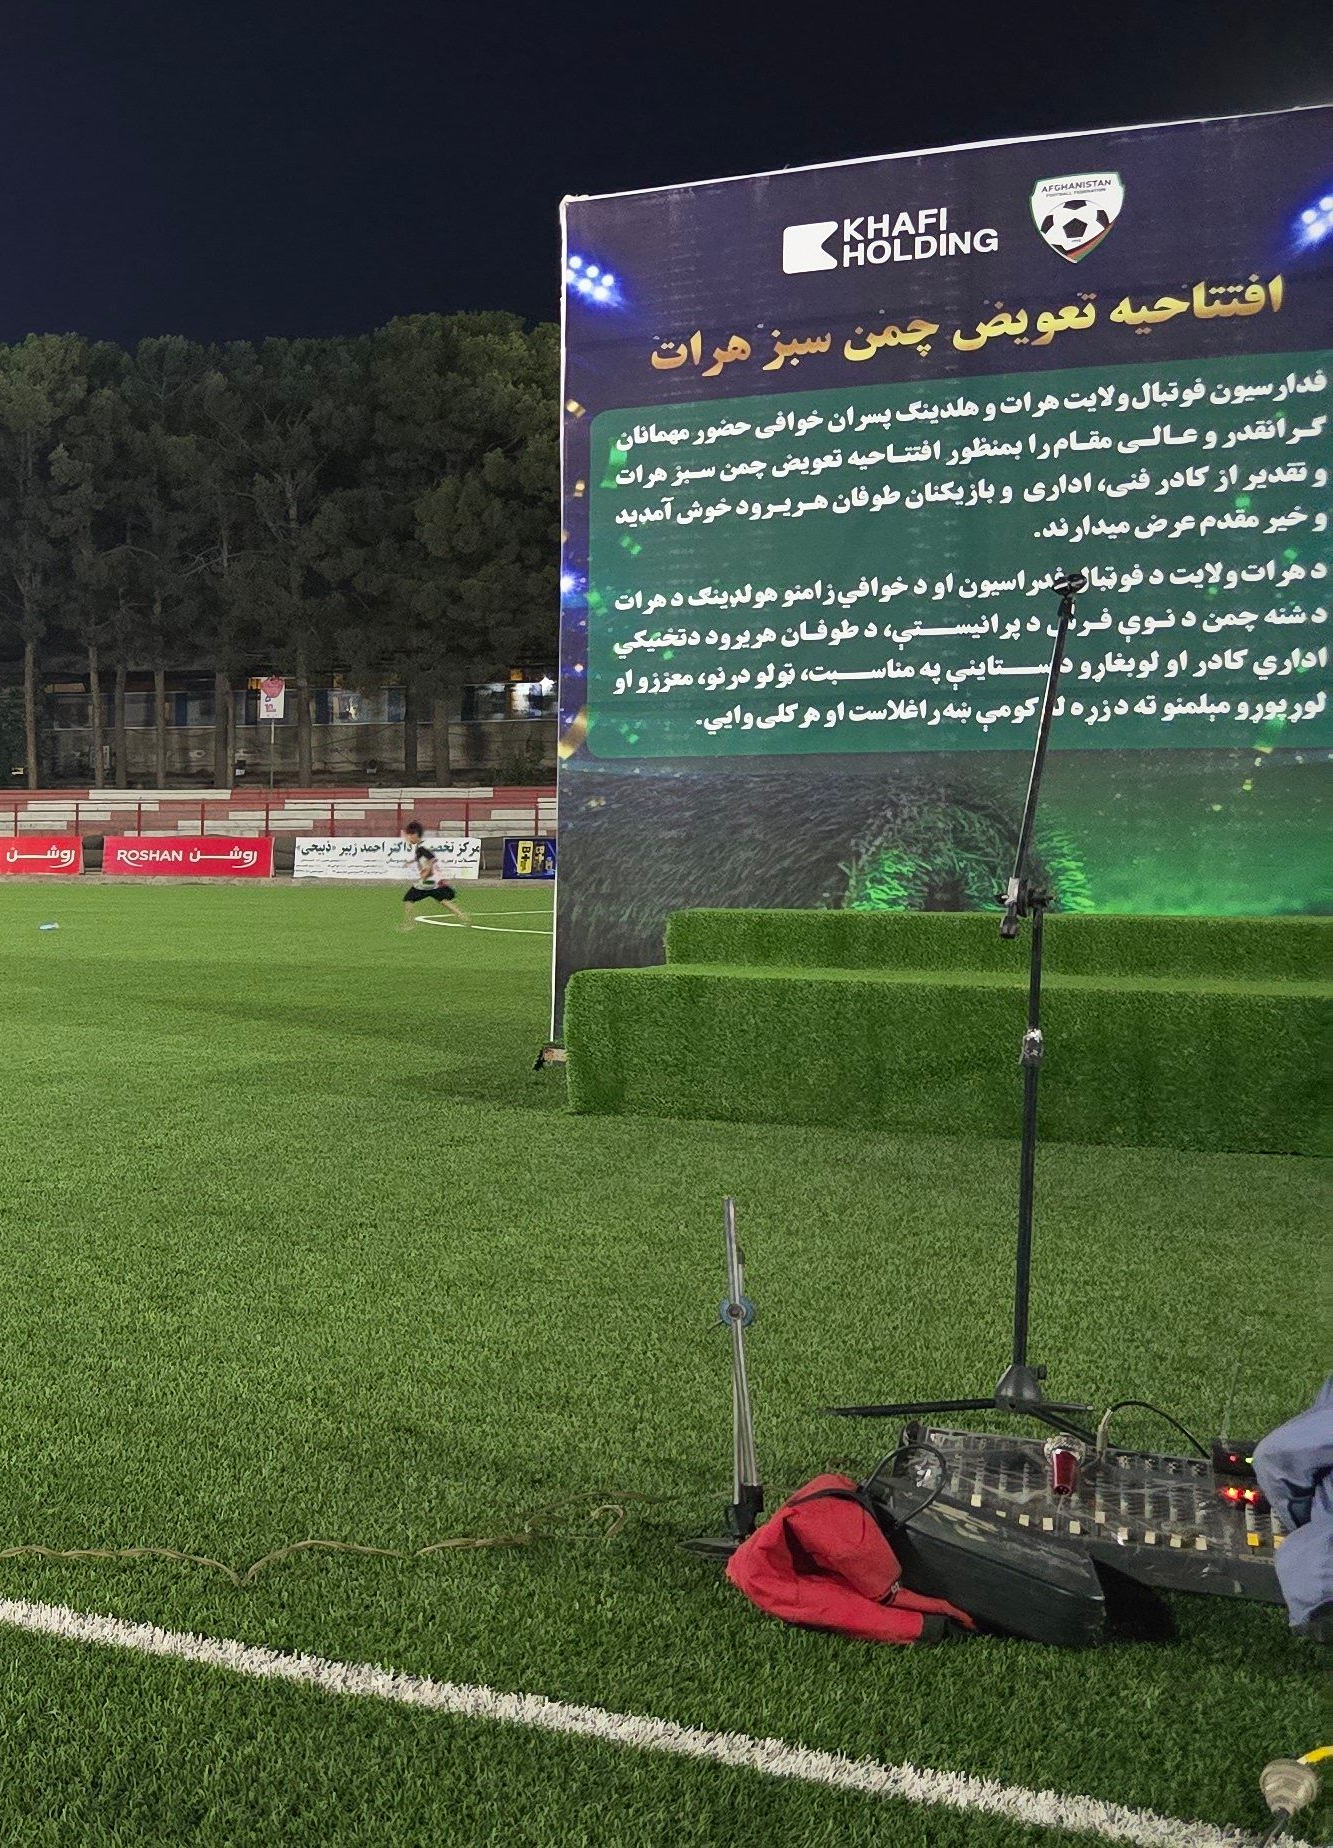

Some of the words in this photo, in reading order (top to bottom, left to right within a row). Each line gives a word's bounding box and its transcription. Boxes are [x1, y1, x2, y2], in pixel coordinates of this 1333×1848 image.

[1041, 180, 1112, 193] AFGHANISTAN
[844, 208, 947, 247] KHAFI
[843, 223, 998, 267] HOLDING
[1110, 274, 1283, 334] افتتاحیه
[952, 294, 1097, 352] تعویض
[758, 324, 830, 370] سبز
[844, 320, 939, 361] چمن
[651, 331, 750, 377] هرات
[1064, 385, 1129, 412] ولایت
[1132, 378, 1205, 409] فوتبال
[1210, 370, 1327, 404] فدارسیون
[983, 403, 996, 421] و
[1000, 392, 1059, 417] هرات
[755, 410, 823, 439] خوافی
[828, 406, 891, 432] پسران
[616, 424, 689, 451] مهمانان
[692, 419, 751, 445] حضور
[1054, 431, 1112, 458] مقام
[1203, 431, 1217, 449] و
[848, 440, 940, 470] افتتاحیه
[946, 437, 1022, 465] بمنظور
[1029, 434, 1050, 459] را
[720, 461, 767, 481] چمن
[772, 449, 842, 477] تعویض
[616, 464, 667, 488] هرات
[671, 466, 715, 486] سبز
[1024, 472, 1091, 502] اداری
[1155, 466, 1209, 495] کادر
[1214, 464, 1237, 492] از
[1242, 462, 1307, 490] تقدیر
[1312, 468, 1327, 487] و
[833, 485, 900, 513] طوفان
[905, 479, 995, 509] بازیکنان
[1000, 486, 1012, 503] و
[616, 497, 674, 527] آمدید
[677, 498, 732, 524] خوش
[736, 495, 828, 520] هریرود
[1263, 506, 1308, 533] خیر
[1134, 515, 1195, 539] عرض
[1200, 509, 1259, 536] مقدم
[1312, 513, 1327, 531] و
[1149, 569, 1164, 584] د
[1170, 562, 1238, 589] ولایت
[1241, 560, 1305, 587] هرات
[1311, 563, 1327, 578] د
[914, 578, 927, 594] د
[932, 573, 953, 600] او
[615, 591, 667, 614] هرات
[671, 592, 683, 606] د
[1027, 616, 1040, 631] د
[1182, 611, 1196, 627] د
[1202, 611, 1258, 632] چمن
[1264, 606, 1307, 624] شنه
[1311, 608, 1327, 623] د
[781, 619, 859, 647] طوفان
[864, 622, 877, 637] د
[920, 662, 941, 684] په
[1164, 650, 1187, 677] او
[1192, 649, 1248, 677] کادر
[613, 669, 632, 694] او
[824, 701, 844, 727] او
[1052, 696, 1065, 716] ل
[1134, 695, 1156, 714] ته
[798, 707, 820, 728] هر
[6, 846, 75, 868] روشن
[117, 849, 182, 867] ROSHAN
[189, 847, 257, 869] روشن
[338, 843, 358, 857] زبیر
[360, 841, 385, 853] احمد
[456, 841, 480, 857] مرکز
